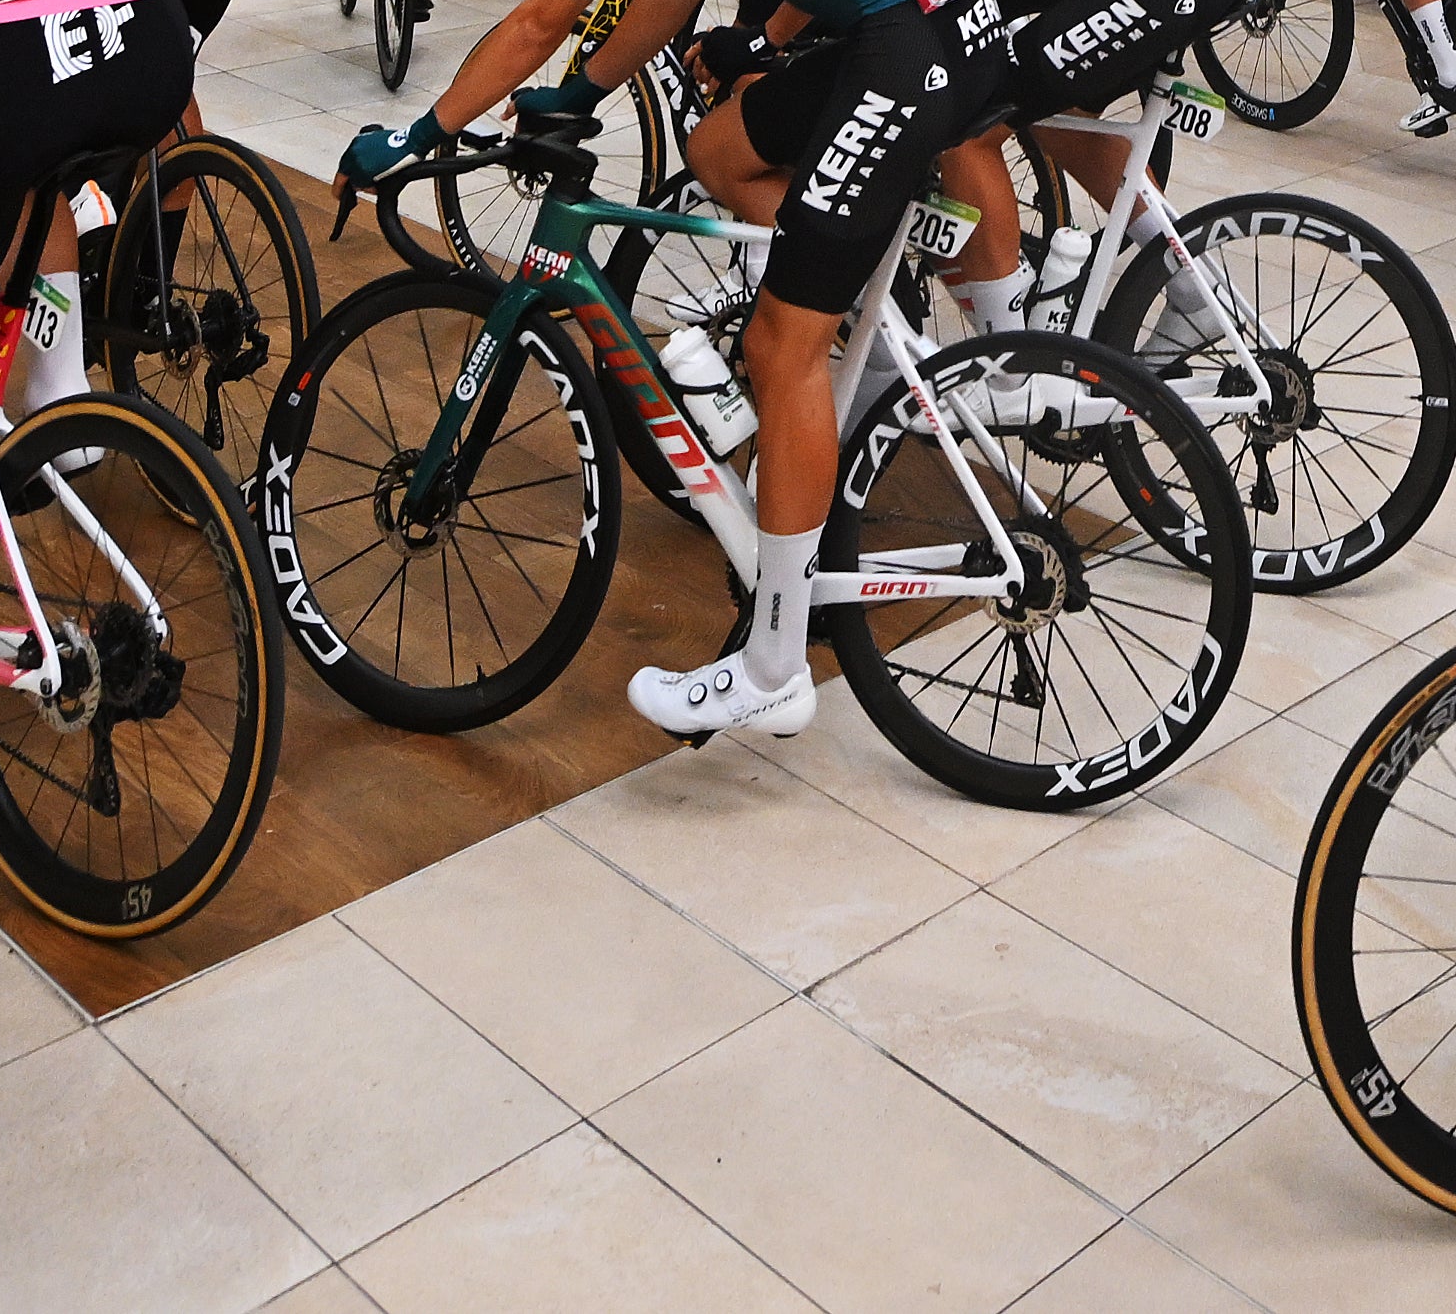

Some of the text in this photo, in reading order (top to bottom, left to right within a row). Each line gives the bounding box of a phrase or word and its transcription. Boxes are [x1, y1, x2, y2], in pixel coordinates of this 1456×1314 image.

[1065, 18, 1163, 81] PHARMA
[1165, 99, 1212, 140] 208
[801, 90, 896, 213] KERN
[837, 103, 918, 218] PHARMA
[526, 243, 571, 272] KERN
[908, 207, 959, 255] 205
[1164, 212, 1386, 270] CADEX
[467, 331, 493, 375] KERN
[522, 329, 600, 560] CADEX
[265, 442, 348, 667] CADEX
[859, 580, 944, 598] GIANT
[1045, 634, 1223, 799] CADEX
